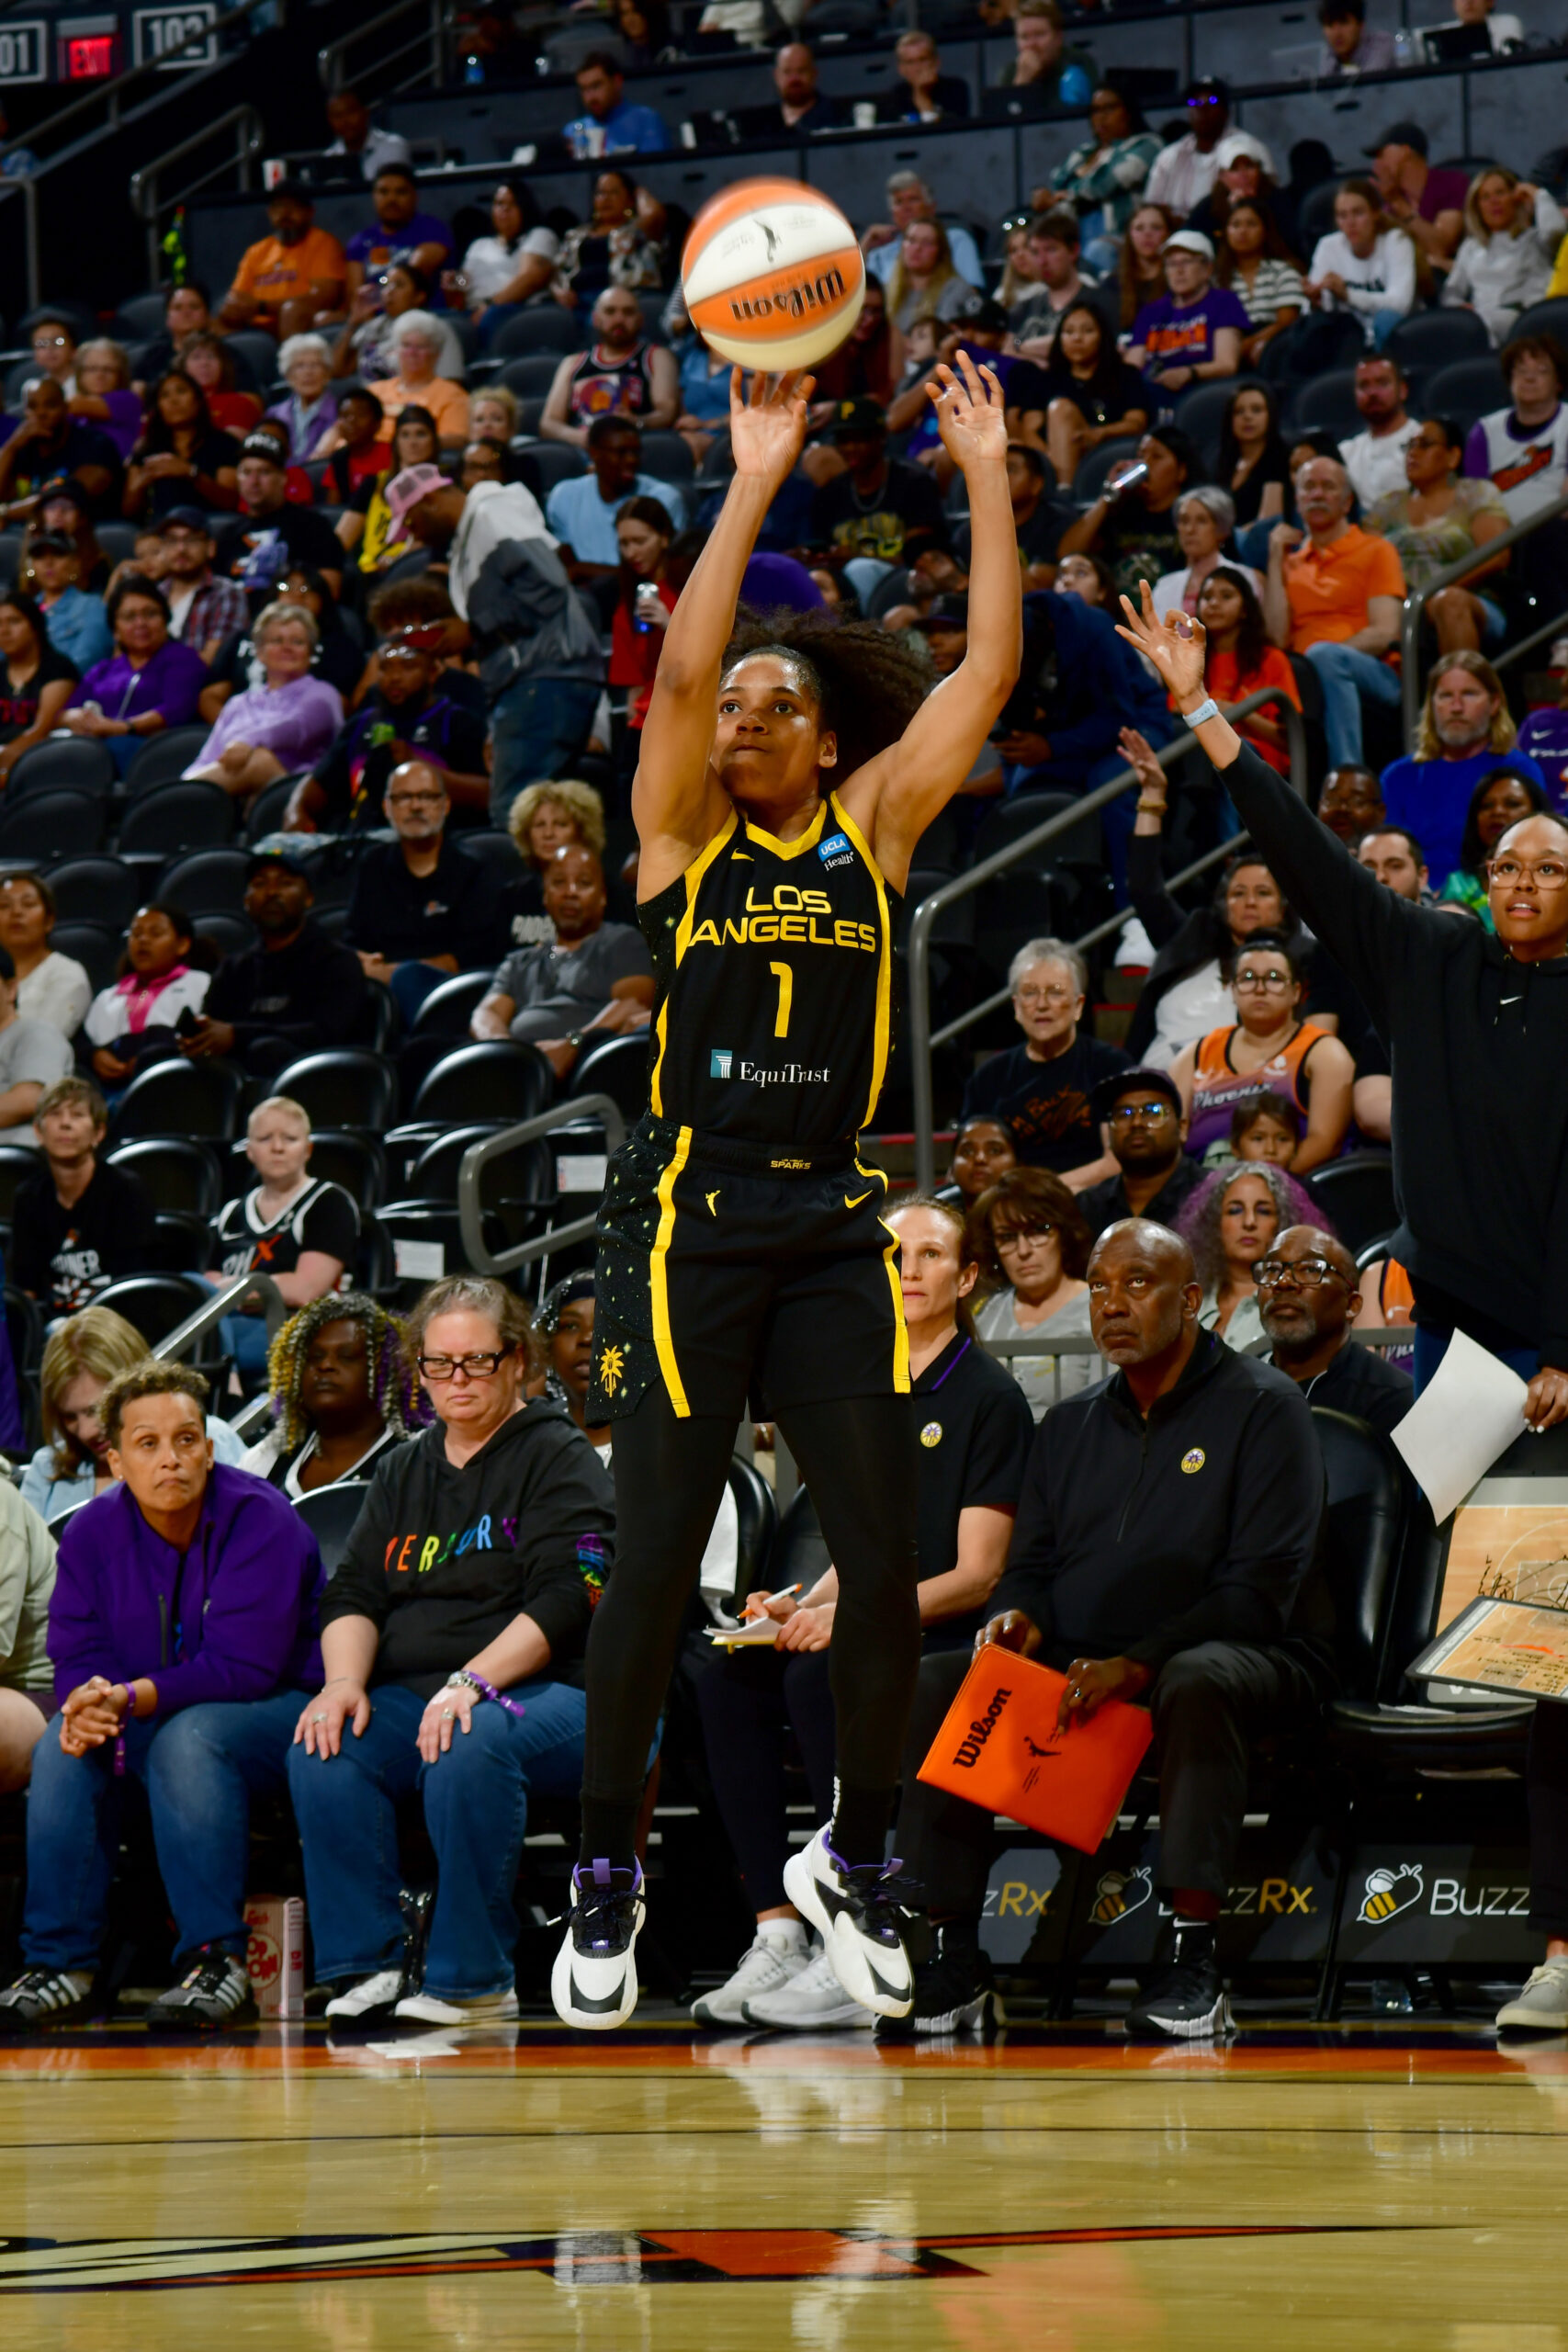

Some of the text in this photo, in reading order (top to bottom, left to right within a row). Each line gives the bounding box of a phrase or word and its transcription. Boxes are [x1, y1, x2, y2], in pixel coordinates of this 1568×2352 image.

[728, 267, 846, 322] Wilson
[840, 401, 855, 420] P
[820, 838, 847, 855] UCLA
[824, 852, 854, 871] Health
[746, 885, 832, 914] LOS
[687, 915, 876, 953] ANGELES
[770, 962, 793, 1037] 1
[739, 1062, 830, 1088] EquiTrust
[1193, 1081, 1274, 1110] Phoenix
[770, 1159, 812, 1170] SPARKS
[953, 1687, 1013, 1769] Wilson
[1429, 1879, 1530, 1916] Buzz
[247, 1935, 268, 1961] OP
[247, 1956, 278, 1981] ORN
